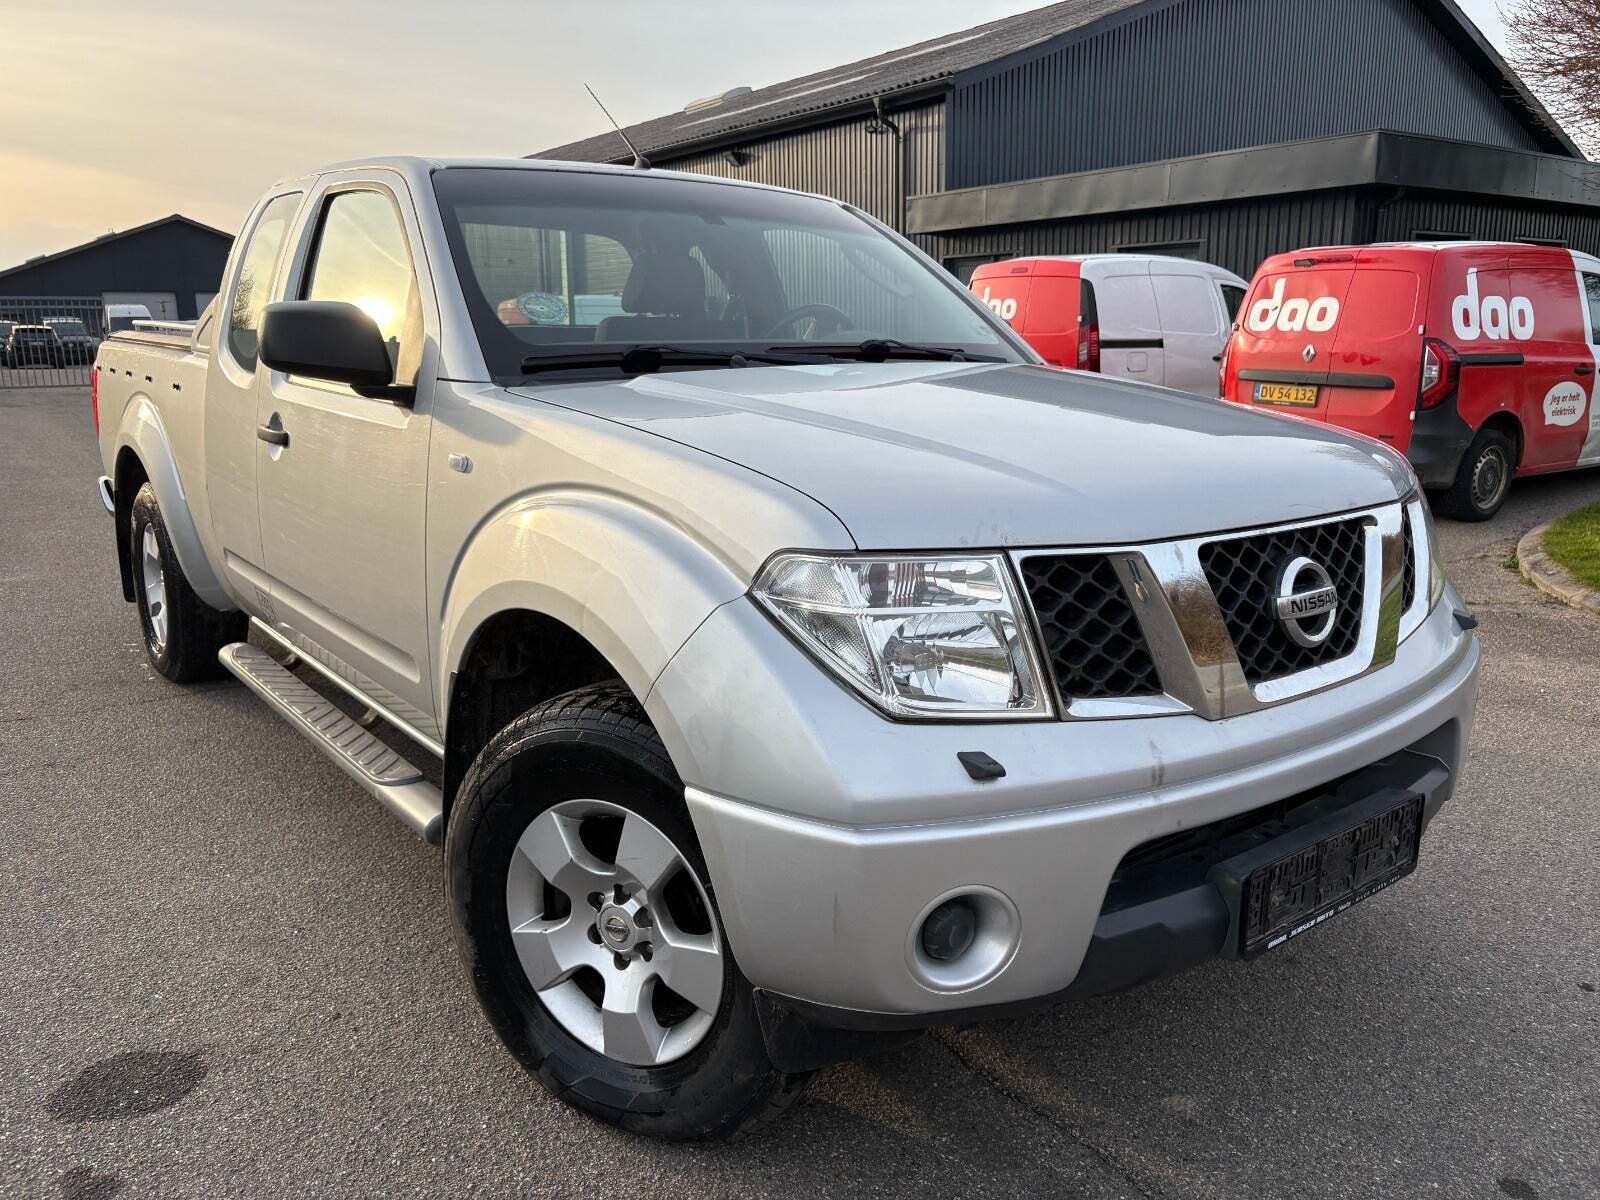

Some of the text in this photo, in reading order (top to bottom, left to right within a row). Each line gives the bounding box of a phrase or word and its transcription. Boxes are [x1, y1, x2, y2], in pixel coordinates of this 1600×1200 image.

[1249, 278, 1339, 332] dao
[1452, 267, 1535, 340] dao
[1261, 386, 1315, 401] DV 54 132
[1550, 393, 1560, 405] Jeg
[1569, 392, 1580, 401] helt
[1552, 406, 1576, 417] elektrisk
[1291, 591, 1337, 614] NISSAN
